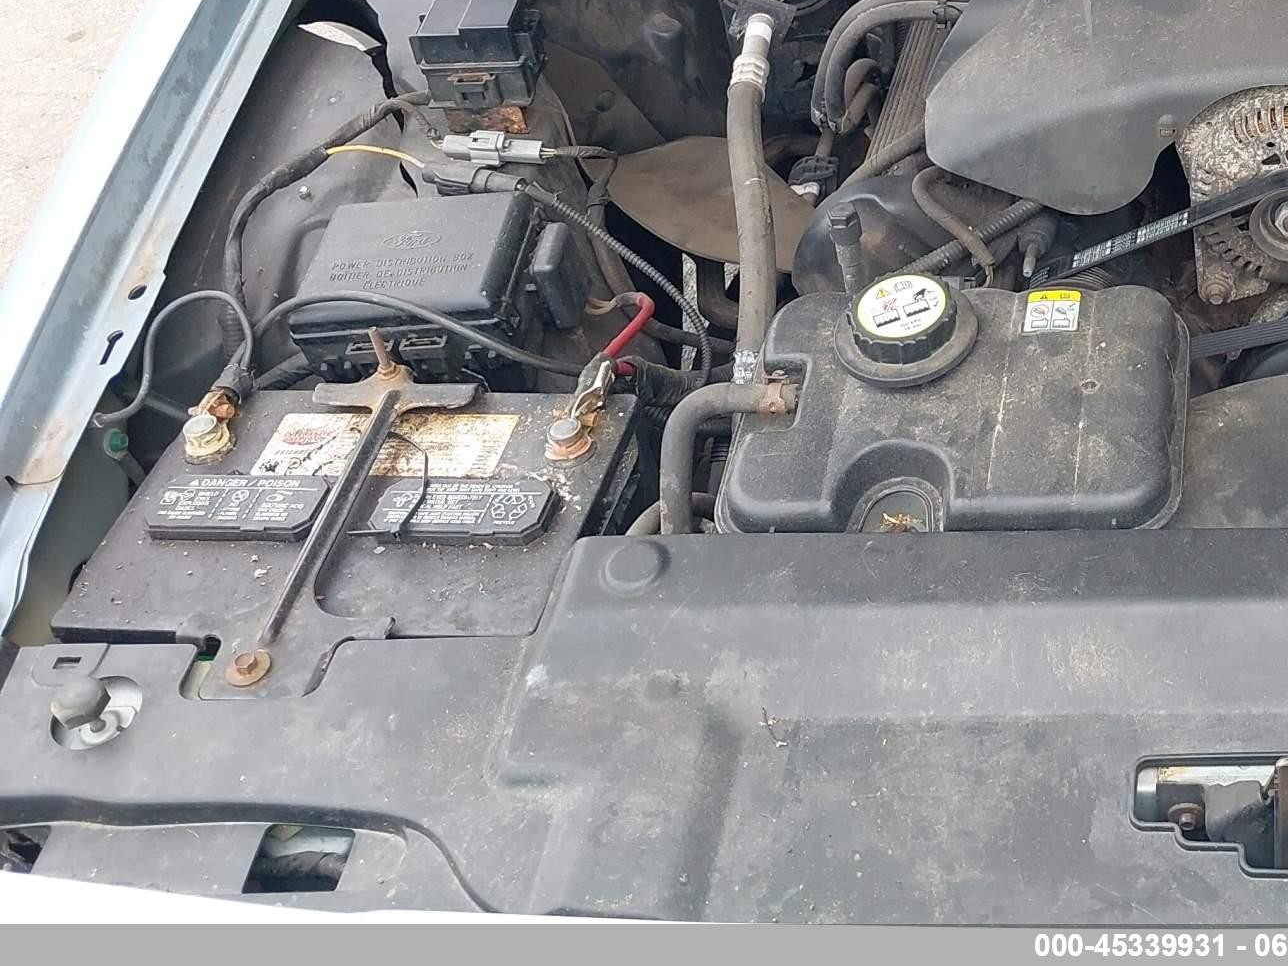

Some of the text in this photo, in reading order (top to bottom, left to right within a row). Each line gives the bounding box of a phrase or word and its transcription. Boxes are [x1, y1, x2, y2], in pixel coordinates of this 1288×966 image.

[331, 251, 476, 271] POWER DISTRIBUTION BOX
[396, 263, 469, 277] DISTRIBUTION
[201, 478, 250, 487] DANGER
[257, 479, 301, 488] POISON
